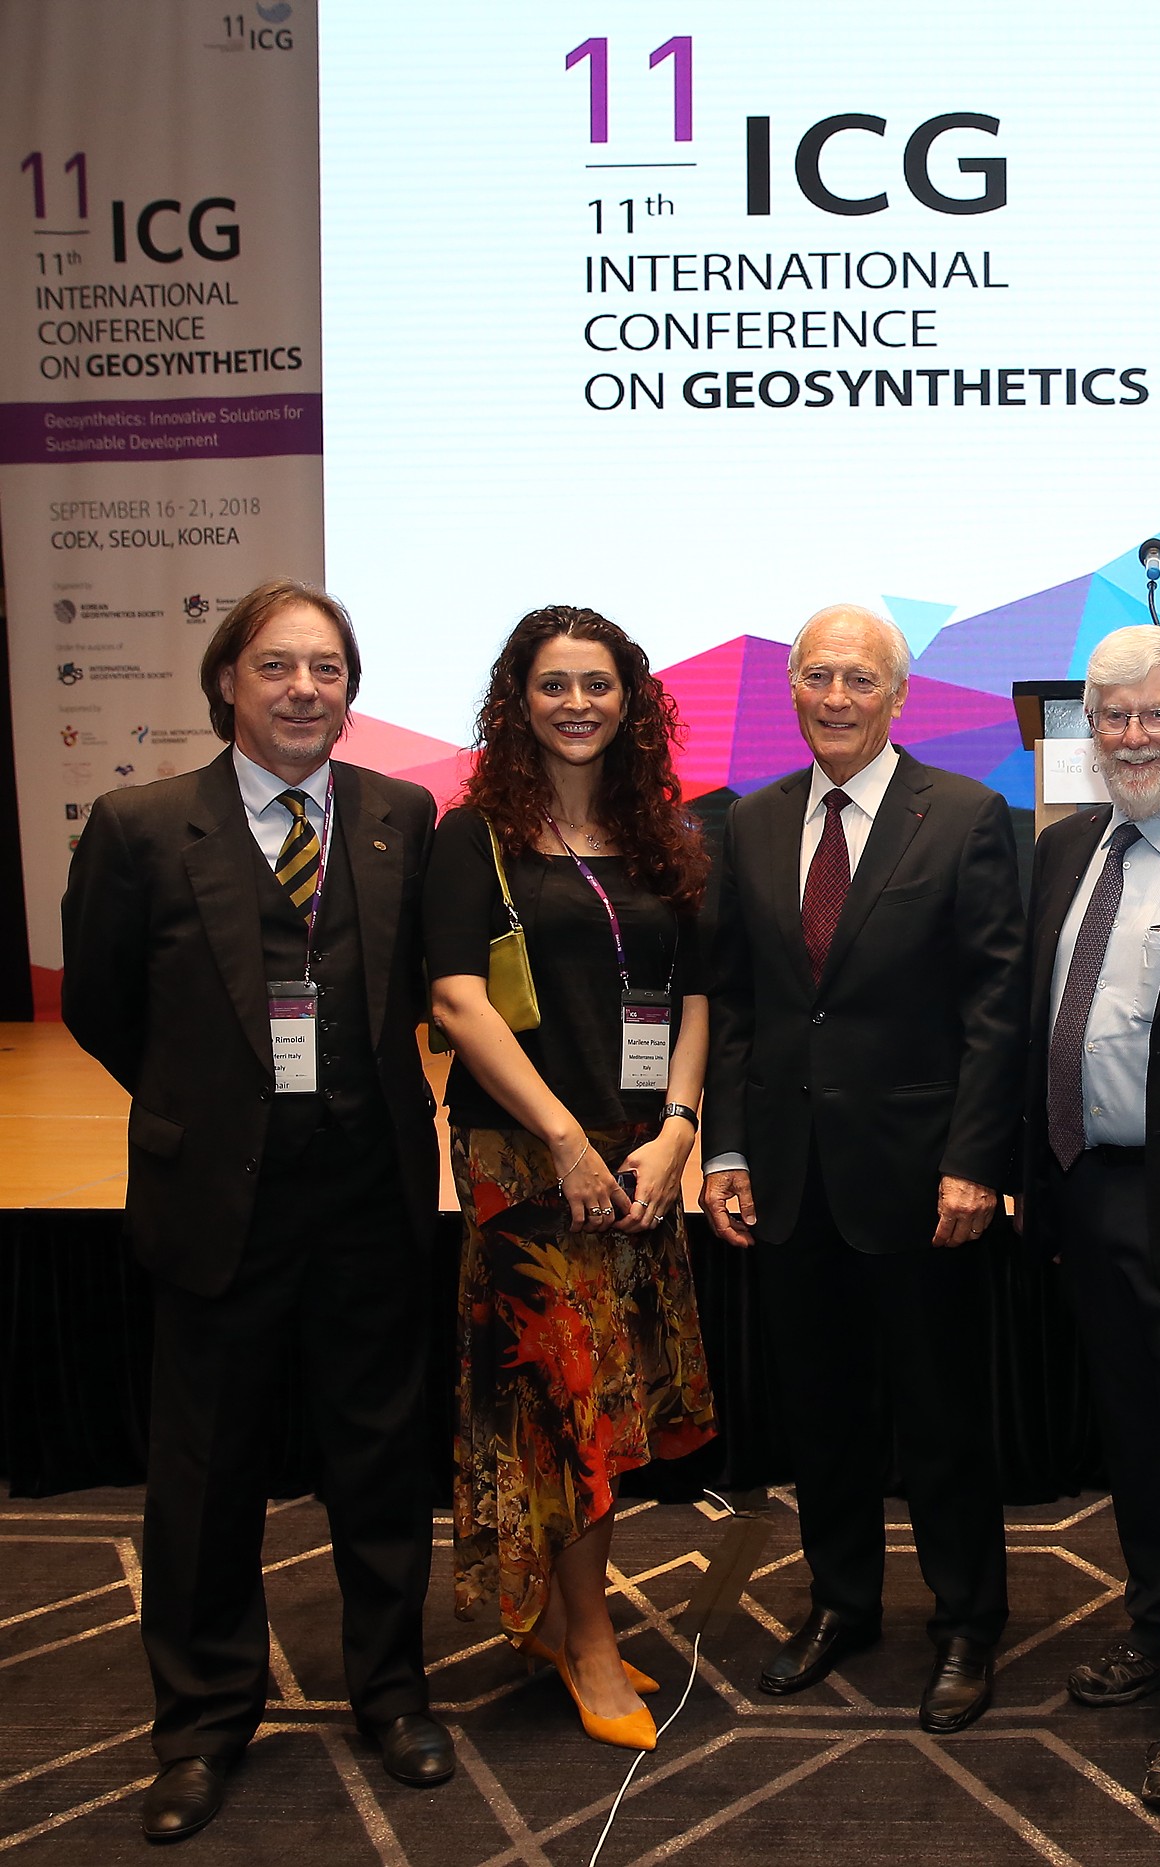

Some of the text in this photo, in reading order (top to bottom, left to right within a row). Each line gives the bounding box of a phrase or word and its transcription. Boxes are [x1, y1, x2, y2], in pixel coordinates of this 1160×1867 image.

[223, 15, 244, 37] 11
[250, 29, 294, 50] ICG
[565, 36, 692, 143] 11
[746, 112, 1008, 216] ICG
[21, 152, 87, 219] 11
[588, 193, 674, 234] 11th
[112, 197, 241, 263] ICG
[36, 251, 81, 276] 11th
[586, 251, 1009, 292] INTERNATIONAL
[36, 282, 238, 310] INTERNATIONAL
[38, 316, 205, 345] CONFERENCE
[585, 310, 937, 351] CONFERENCE
[40, 347, 303, 380] ON GEOSYNTHETICS
[585, 368, 1149, 410] ON GEOSYNTHETICS
[44, 404, 304, 430] Geosynthetics: Innovative Solutions for
[46, 433, 218, 451] Sustainable Development
[50, 501, 150, 522] SEPTEMBER
[219, 497, 261, 516] 2018
[51, 527, 240, 551] COEX, SEOUL, KOREA
[1066, 765, 1082, 773] ICG
